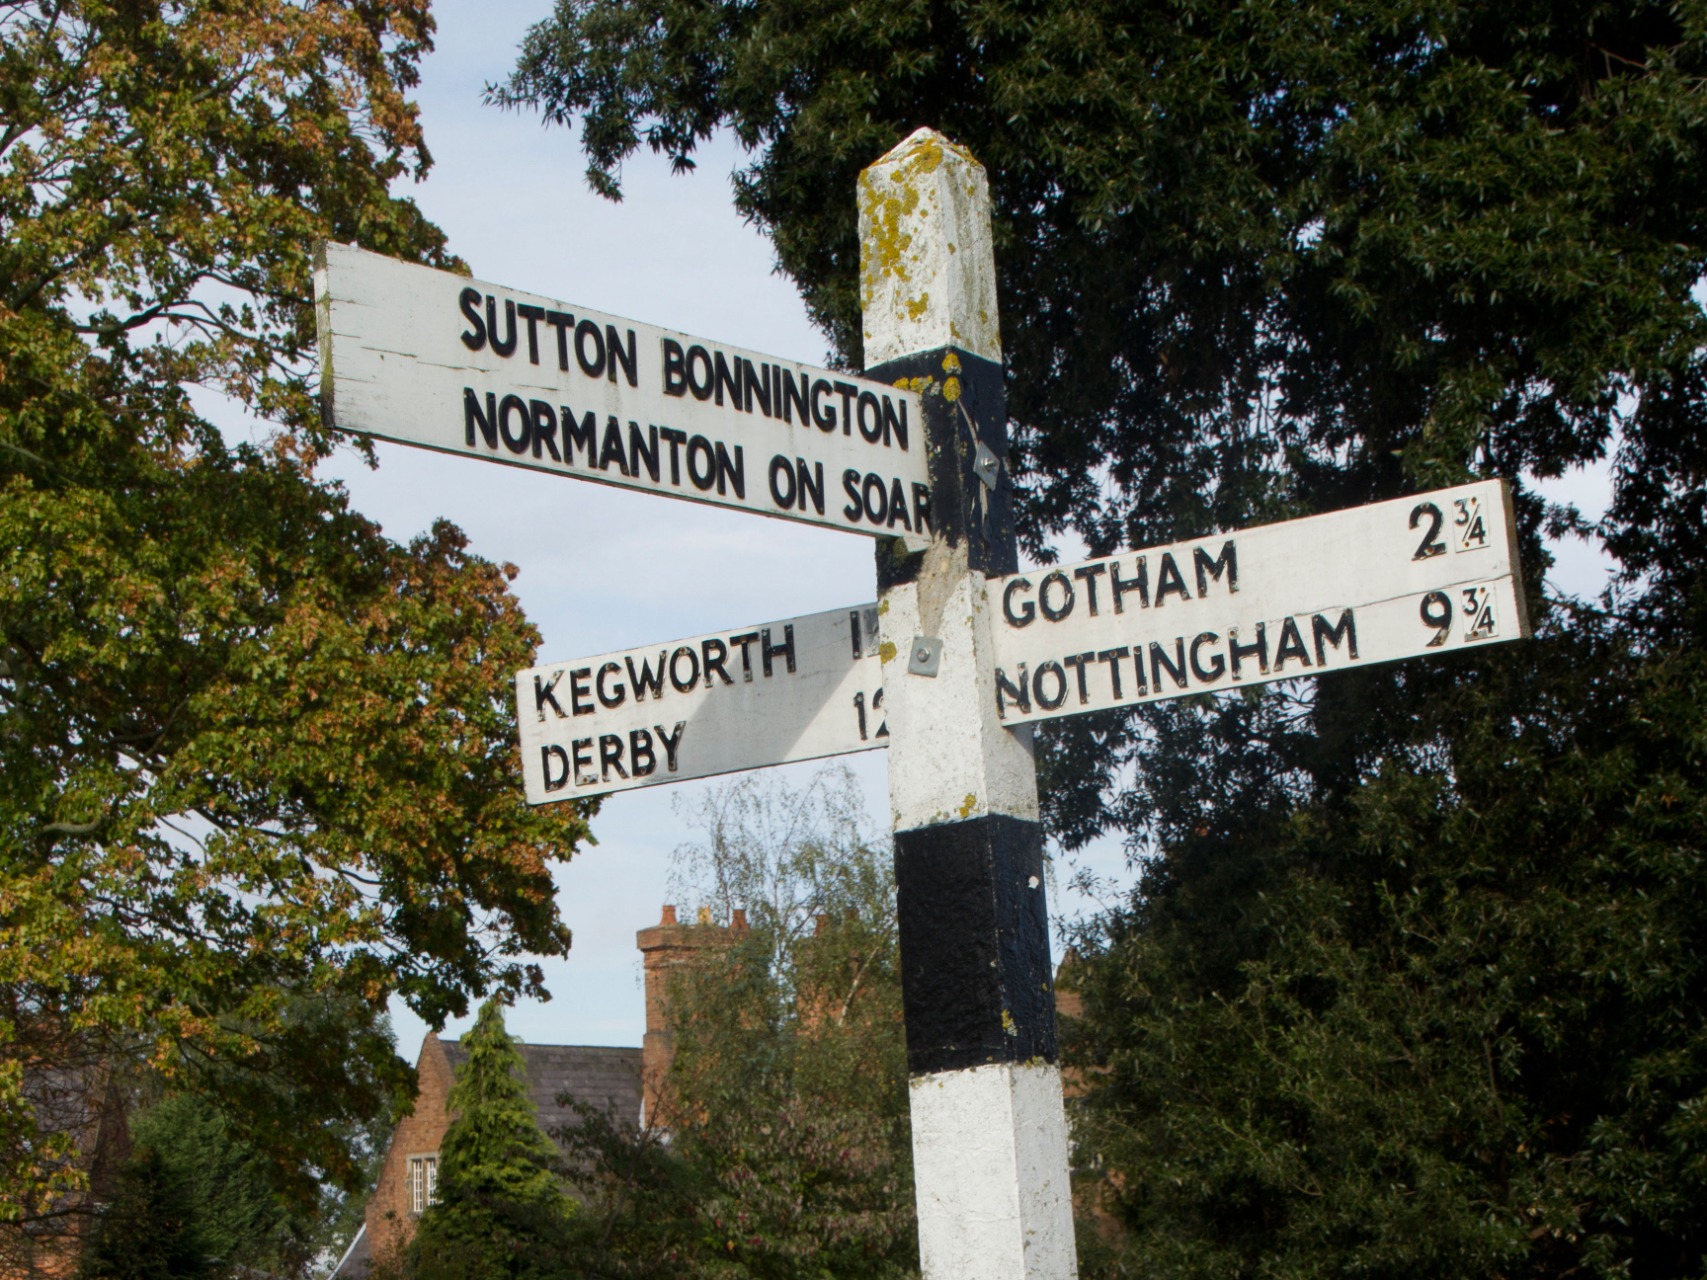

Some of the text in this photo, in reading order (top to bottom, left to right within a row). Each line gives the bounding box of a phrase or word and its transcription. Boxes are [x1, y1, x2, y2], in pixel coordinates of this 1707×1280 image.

[459, 287, 908, 451] SUTTON BONNINGTON
[463, 387, 932, 534] NORMANTON ON SOAR
[1002, 540, 1238, 628] GOTHAM
[534, 624, 797, 722] KEGWORTH
[995, 608, 1359, 719] NOTTINGHAM
[541, 721, 686, 793] DERBY
